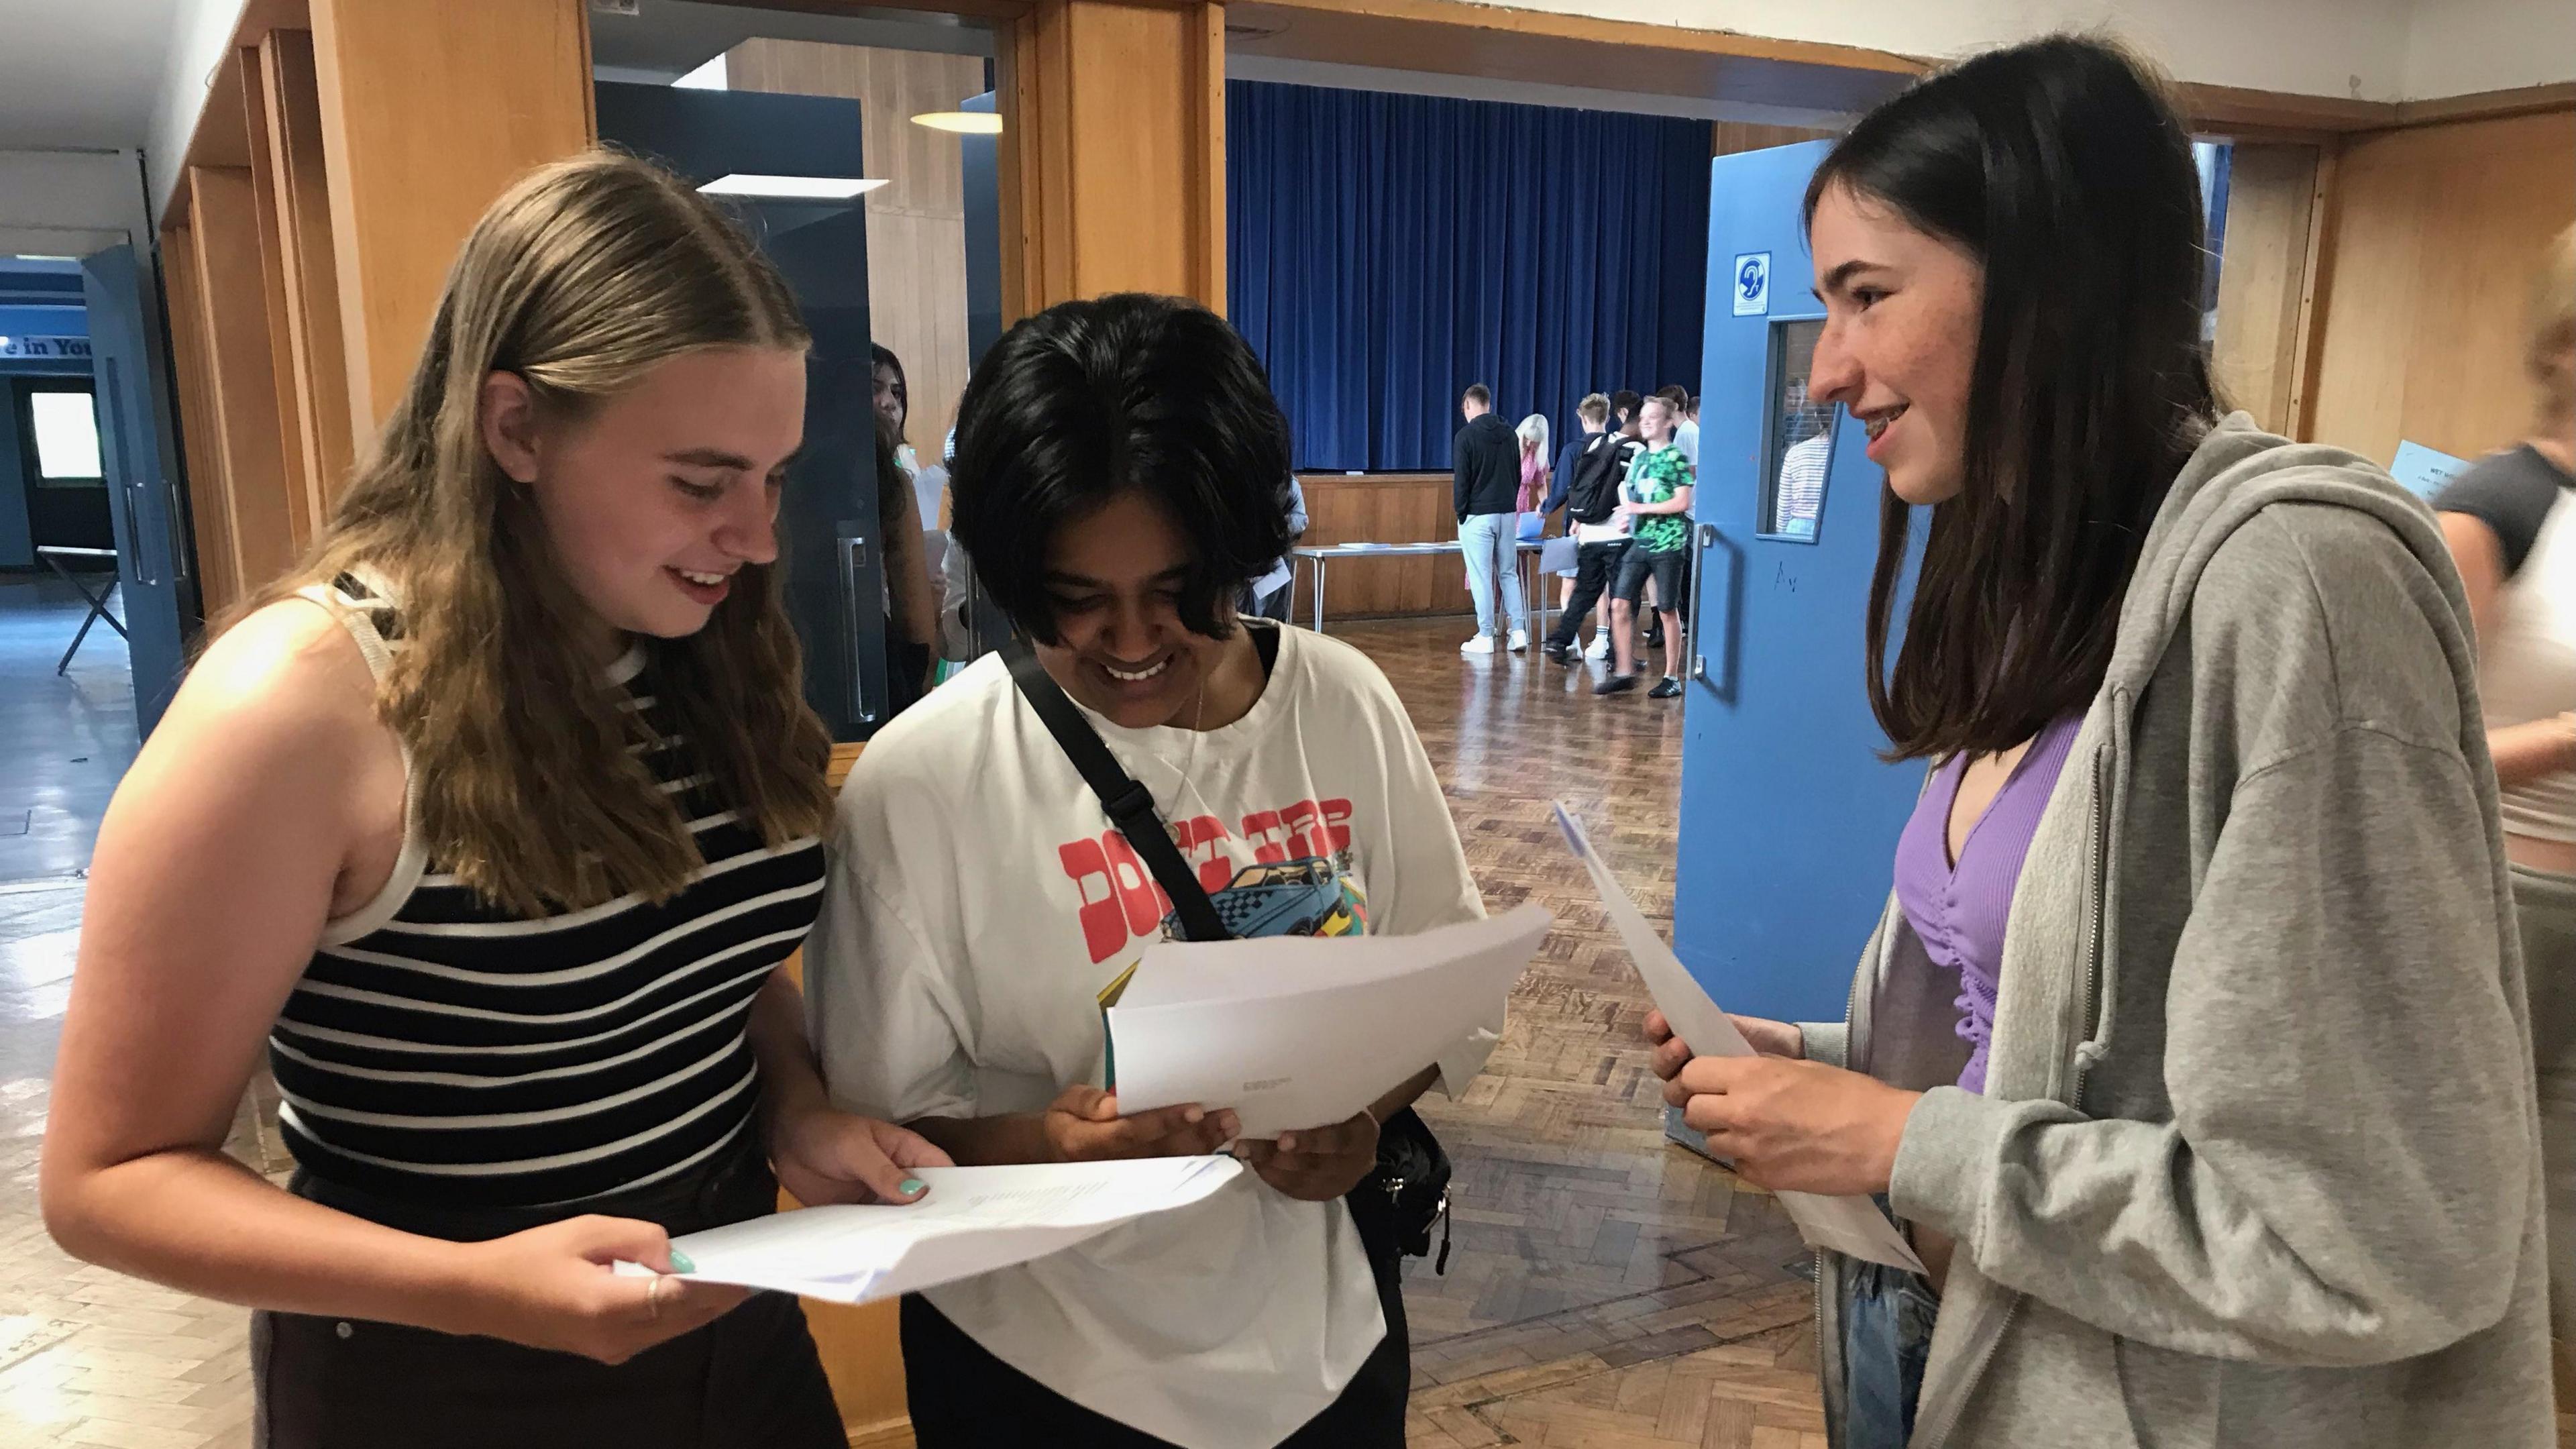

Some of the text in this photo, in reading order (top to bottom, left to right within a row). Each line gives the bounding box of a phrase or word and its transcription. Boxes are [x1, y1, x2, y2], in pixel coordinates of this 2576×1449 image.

[3, 343, 17, 355] e
[23, 337, 48, 355] in
[1059, 816, 1231, 964] DOT
